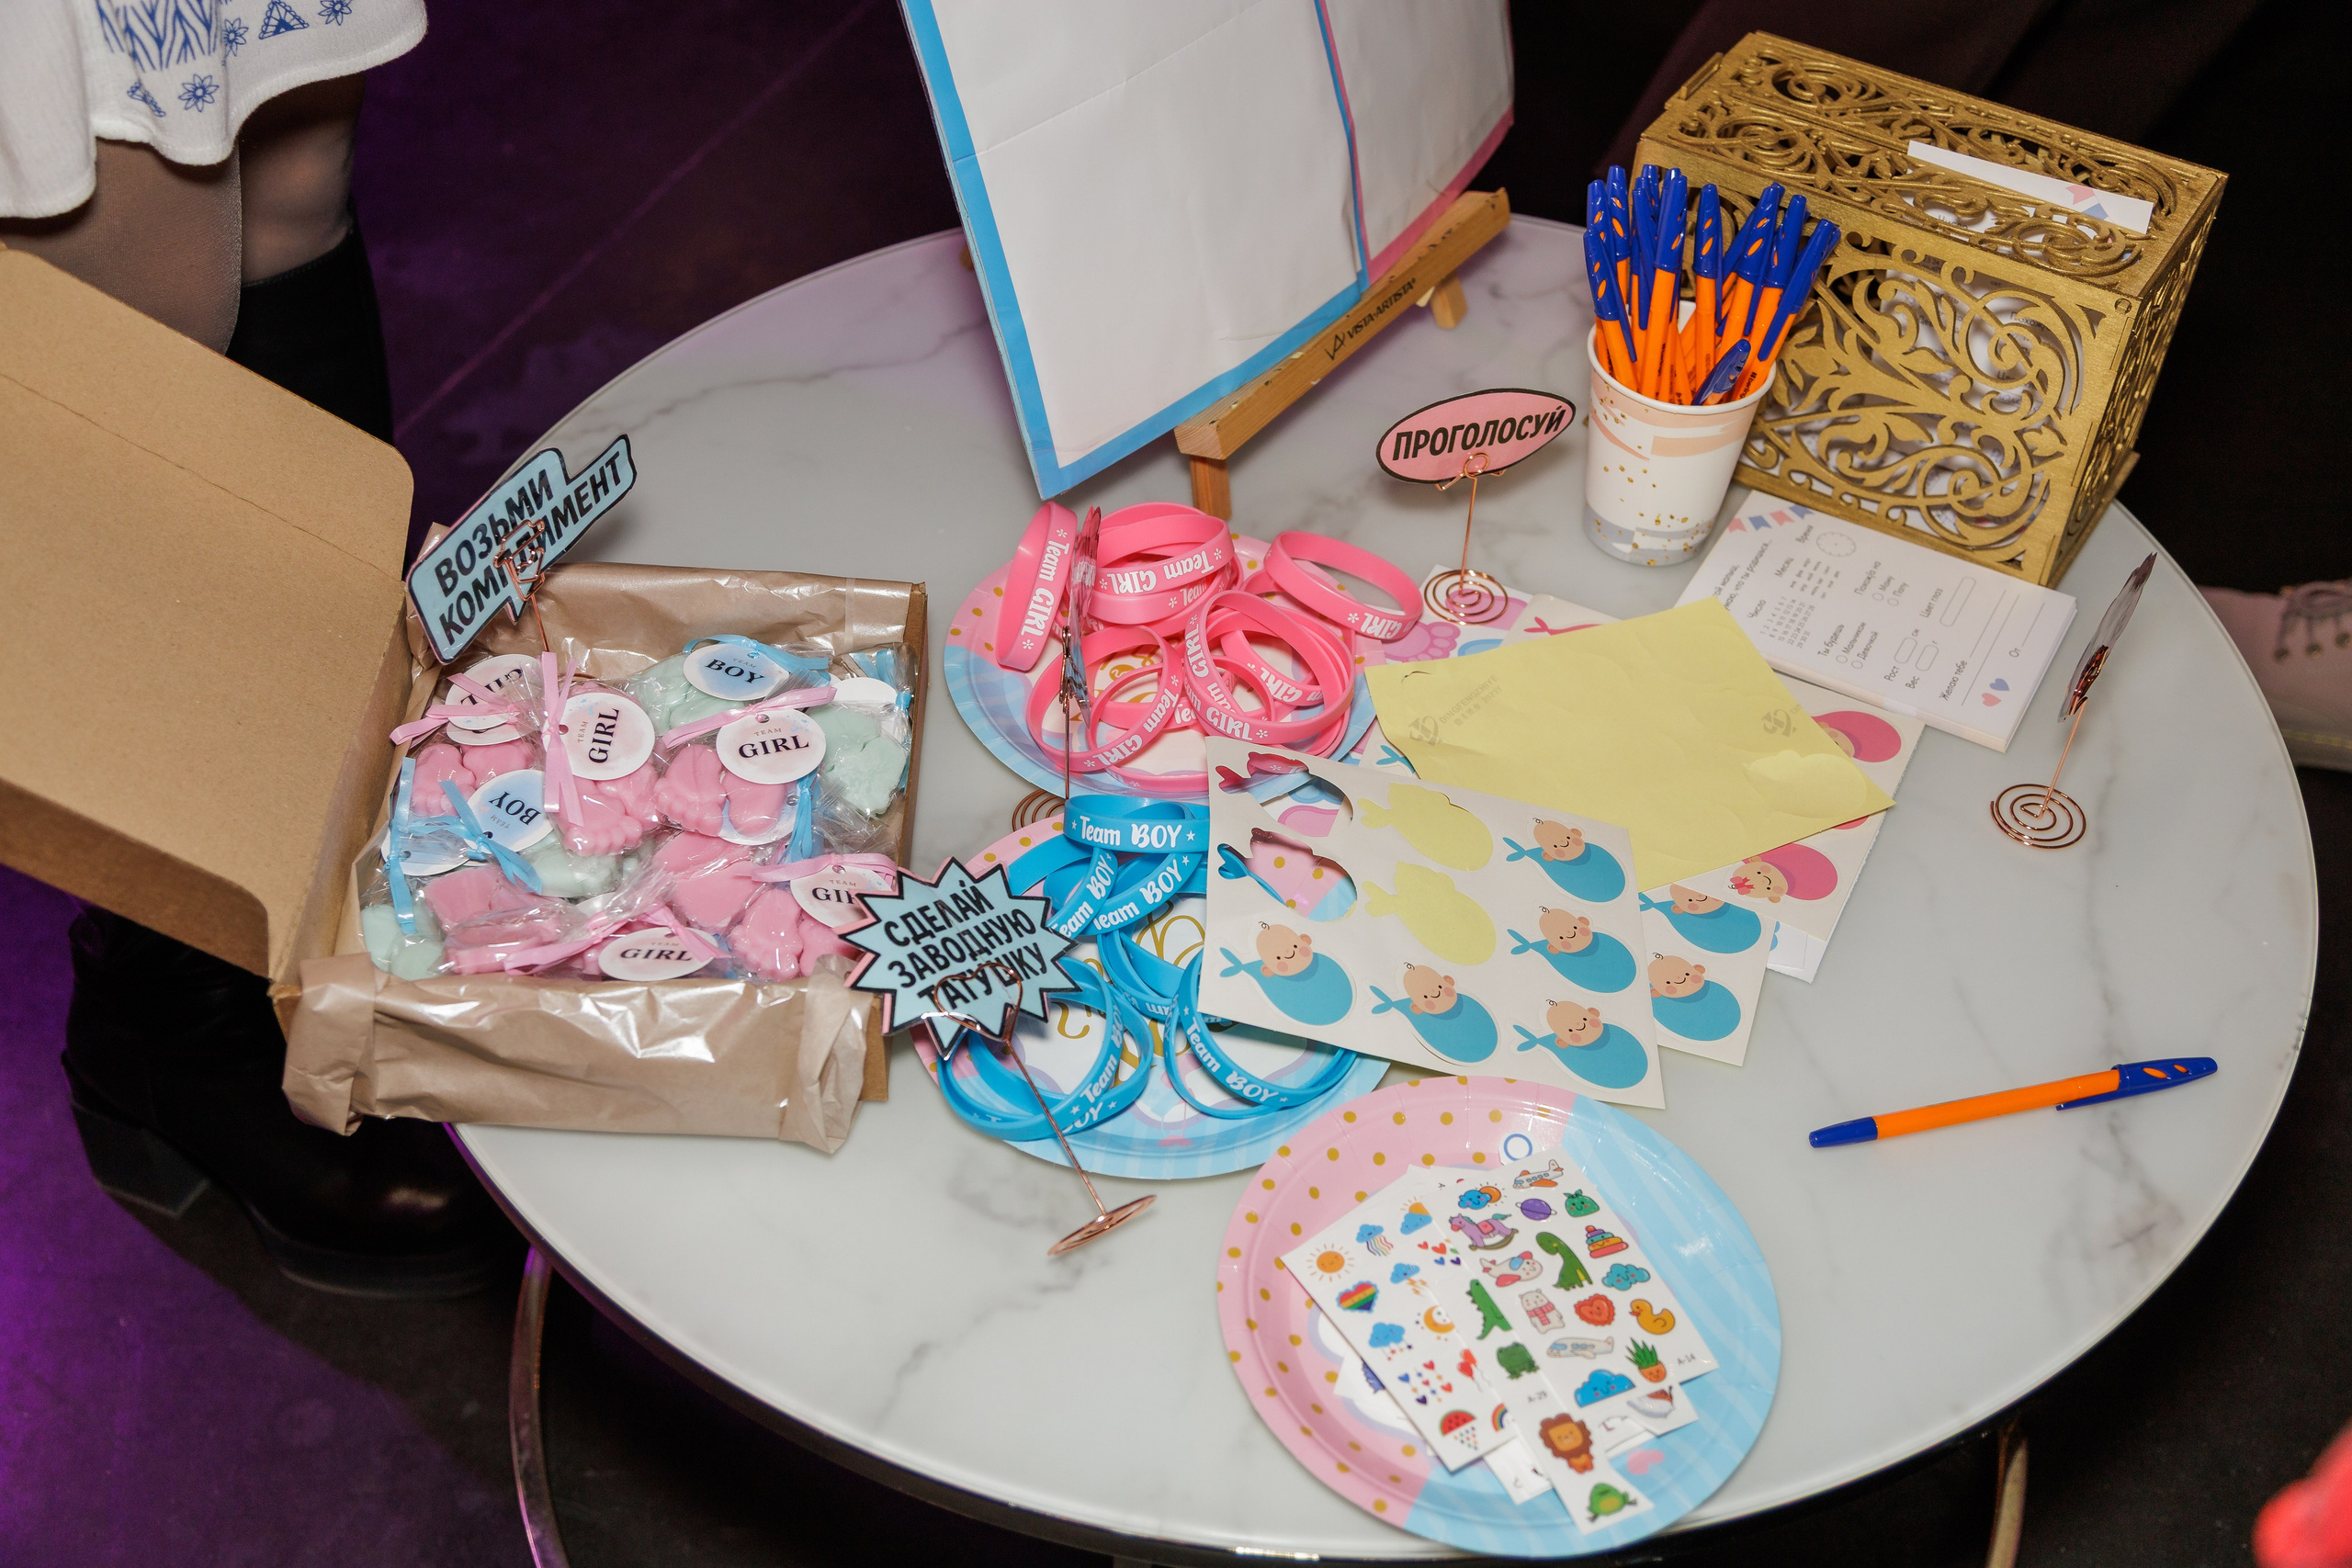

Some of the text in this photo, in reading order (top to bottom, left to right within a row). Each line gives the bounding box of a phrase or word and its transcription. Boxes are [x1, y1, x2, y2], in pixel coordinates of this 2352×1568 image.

[1392, 405, 1566, 461] ПРОГОЛОСУЙ
[435, 469, 553, 597] ВОЗЬМИ
[1795, 525, 1815, 544] Время
[1163, 550, 1215, 580] Team
[1774, 557, 1794, 578] Месяц
[1021, 539, 1070, 637] Team GIRL
[1107, 570, 1157, 594] GIRL
[1747, 599, 1767, 619] Число
[1918, 588, 1943, 618] Цвет глаз
[1360, 612, 1403, 639] GIRL
[1817, 624, 1845, 657] Ты будешь
[1841, 621, 1867, 655] Мальчиком
[1185, 623, 1209, 678] GIRL
[1856, 630, 1880, 660] Девочкой
[1883, 628, 1919, 682] Рост см
[2008, 647, 2021, 659] От
[705, 659, 766, 684] BOY
[732, 657, 757, 669] TEAM
[1260, 667, 1303, 703] GIRL
[1905, 675, 1920, 690] Вес
[1939, 660, 1968, 701] Желаю тебе
[578, 720, 587, 743] TEAM
[588, 707, 620, 763] GIRL
[753, 727, 782, 737] TEAM
[1092, 688, 1180, 763] Team GIRL
[1205, 706, 1253, 740] GIRL
[738, 734, 809, 759] GIRL
[489, 791, 541, 826] BOY
[489, 814, 511, 829] TEAM
[1080, 816, 1182, 848] Team BOY
[829, 879, 856, 887] TEAM
[1086, 853, 1116, 899] BOY
[1139, 859, 1183, 906] BOY
[884, 880, 995, 947] СДЕЛАЙ
[620, 948, 694, 962] GIRL
[888, 908, 1036, 987] ЗАВОДНУЮ
[918, 942, 1047, 1010] ТАТУШКУ
[1186, 1017, 1279, 1102] Team BOY
[1080, 1054, 1117, 1103] Team
